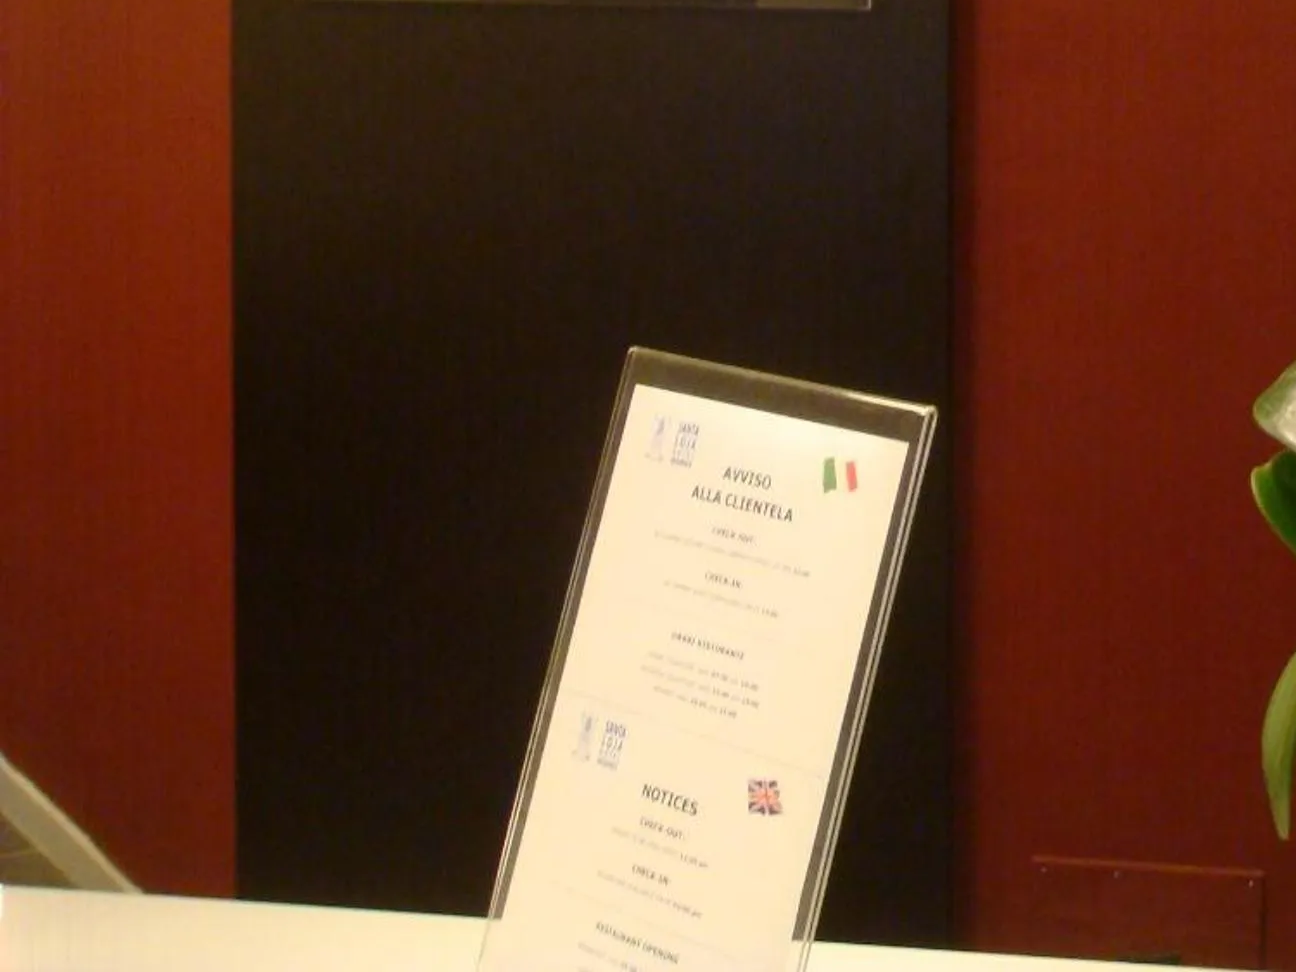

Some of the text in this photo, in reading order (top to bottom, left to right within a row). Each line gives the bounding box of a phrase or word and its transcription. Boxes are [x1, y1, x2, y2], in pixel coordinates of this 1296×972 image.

[722, 466, 772, 490] AVVISO
[691, 484, 793, 522] ALLA CLIENTELA
[641, 783, 699, 817] NOTICES
